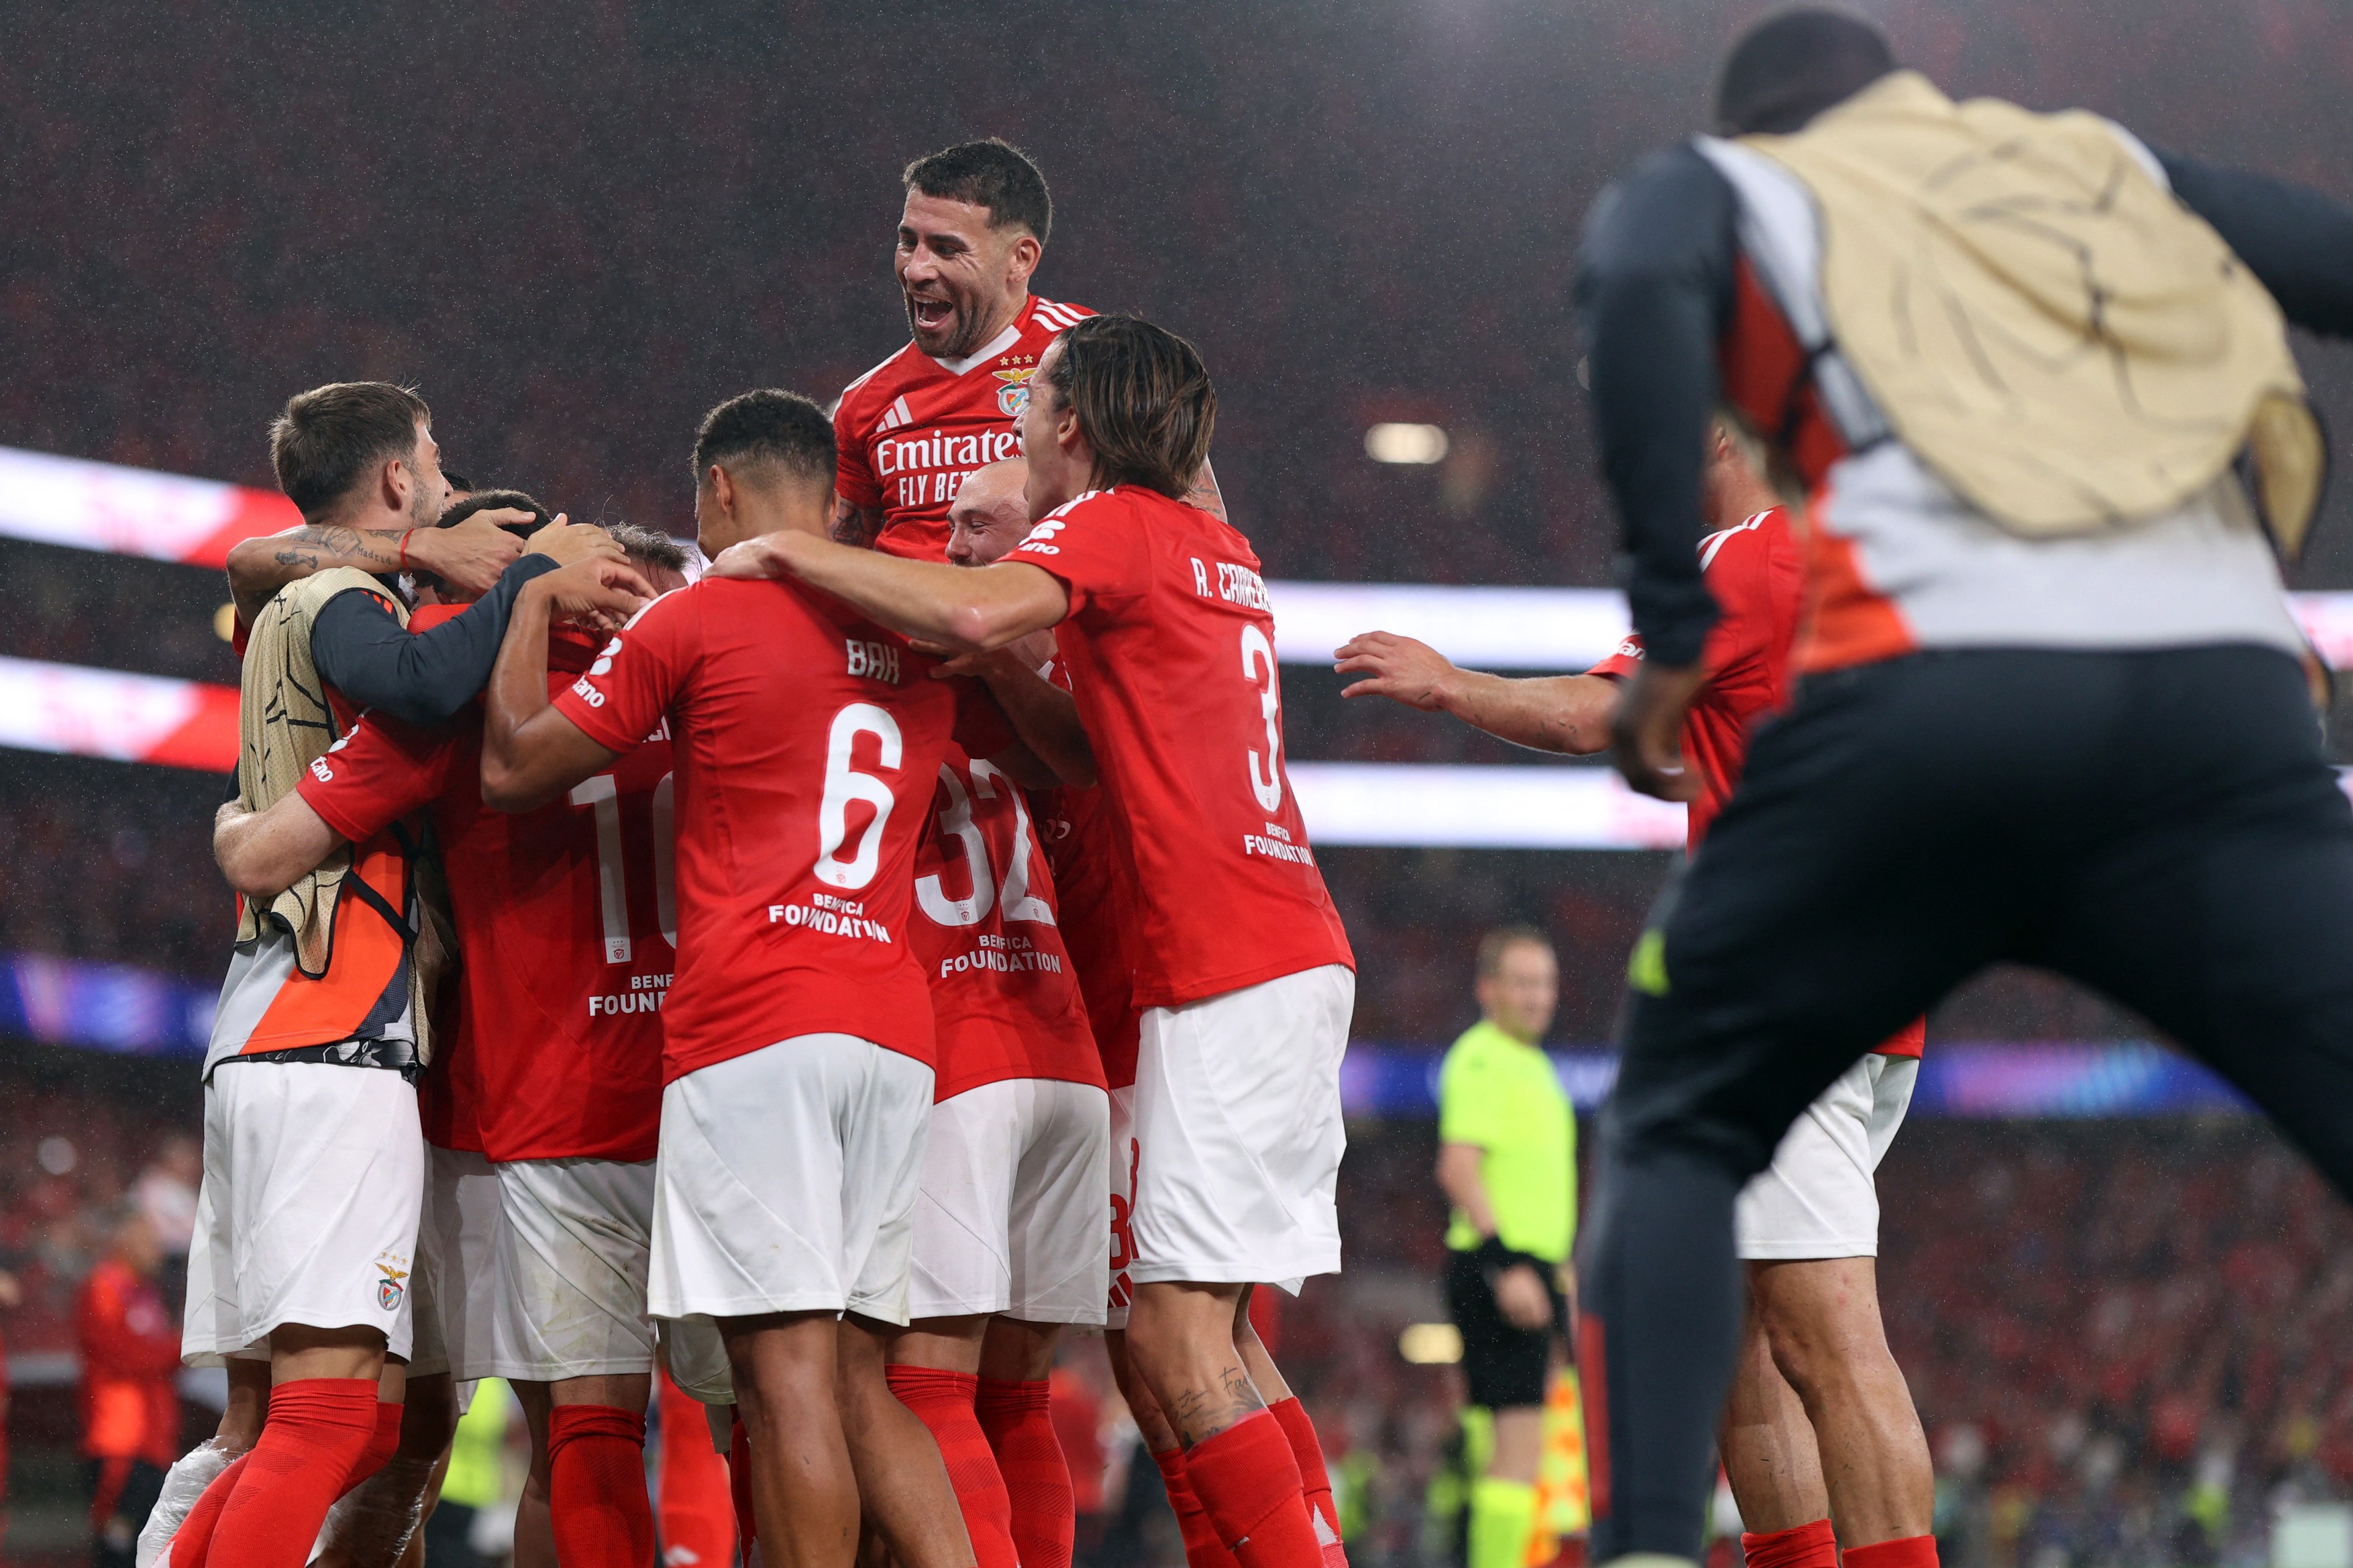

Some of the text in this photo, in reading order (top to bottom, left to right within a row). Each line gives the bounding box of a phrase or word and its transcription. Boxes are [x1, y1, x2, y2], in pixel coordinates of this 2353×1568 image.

[899, 474, 928, 507] FLY
[357, 547, 391, 565] Madrid
[1190, 556, 1213, 598] R.
[845, 638, 900, 684] BAH
[1241, 624, 1282, 813] 3
[813, 702, 903, 890] 6
[914, 758, 1057, 927] 32
[1265, 821, 1291, 843] BENFICA
[1243, 834, 1314, 868] FOUNDATION
[768, 904, 892, 944] FOUNDATIN
[978, 935, 1033, 949] BENFICA
[941, 951, 1062, 979] FOUNDATION
